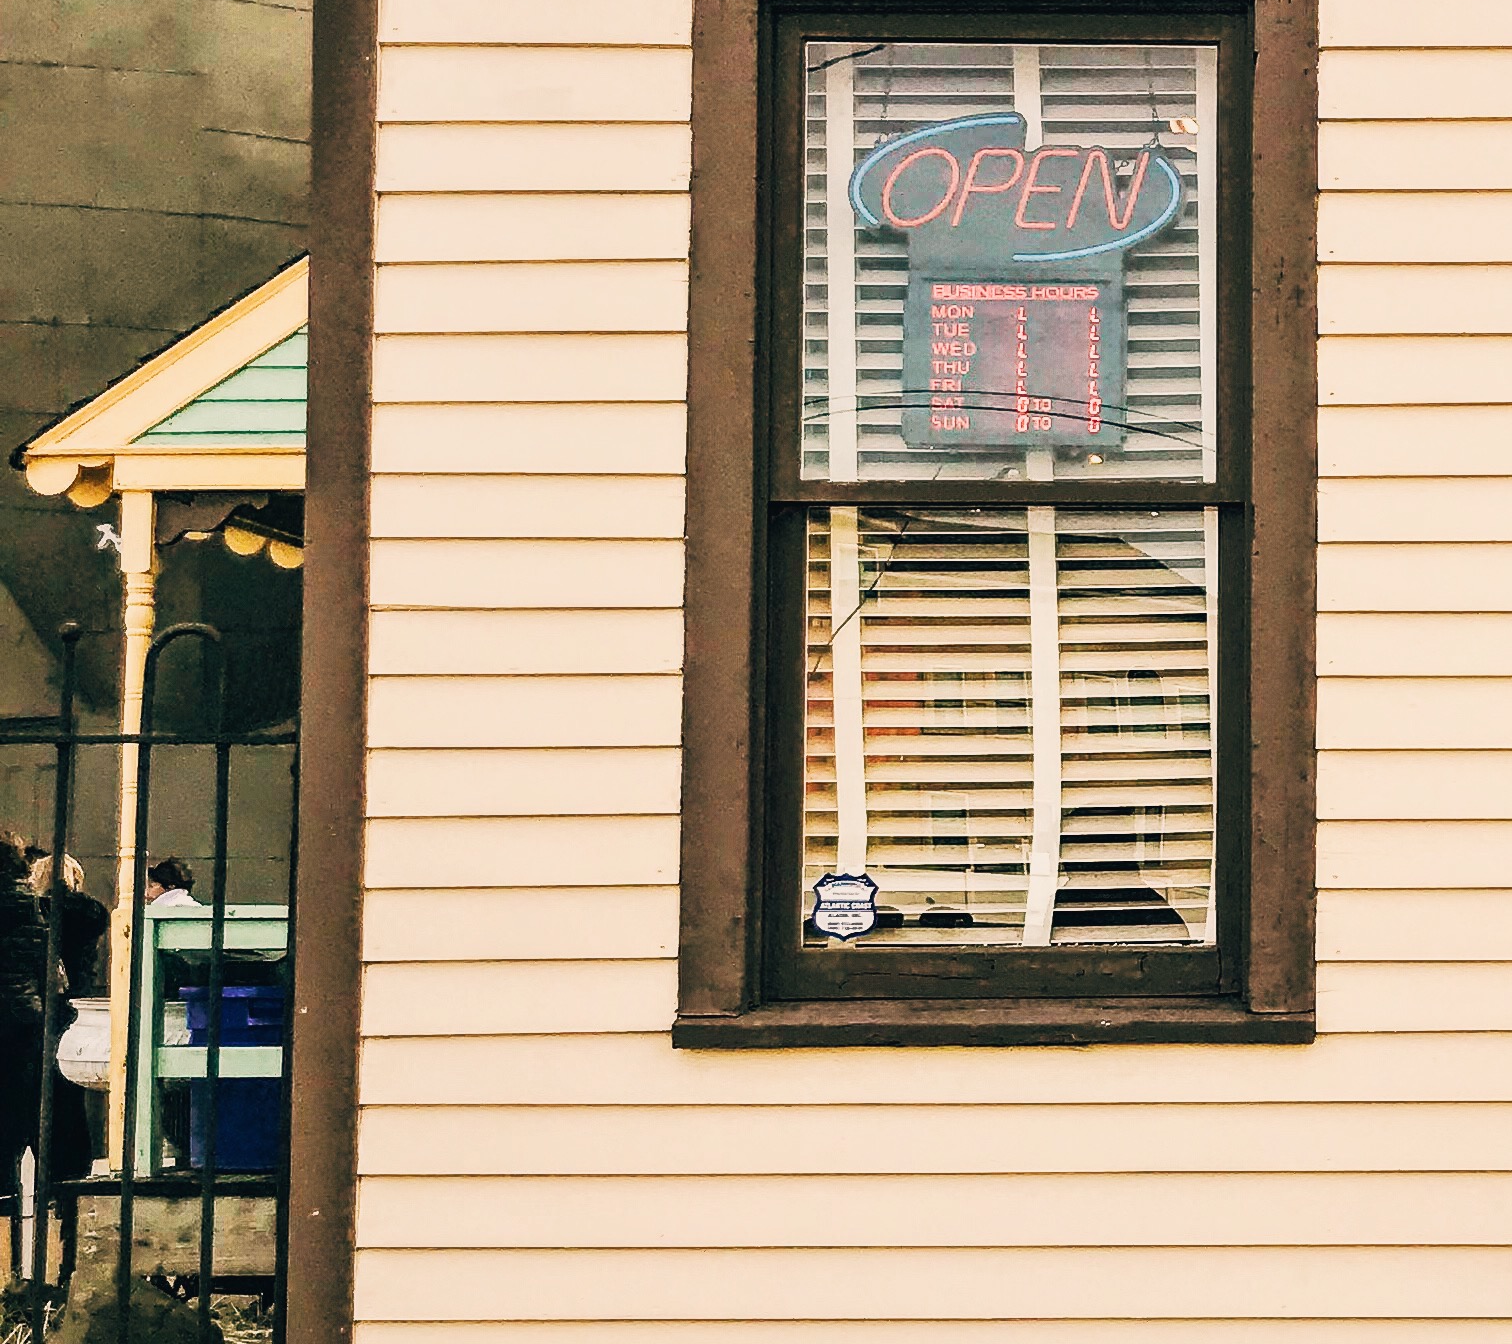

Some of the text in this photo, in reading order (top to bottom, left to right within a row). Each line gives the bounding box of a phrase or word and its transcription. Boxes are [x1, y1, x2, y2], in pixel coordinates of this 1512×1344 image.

[881, 147, 1150, 230] OPEN
[932, 284, 1100, 300] BUSINESS HOURS
[931, 304, 975, 319] MON
[932, 322, 970, 337] TUE
[931, 341, 977, 356] WED
[932, 360, 970, 375] THU
[930, 378, 963, 392] FRI
[931, 396, 965, 411] SAT
[1032, 398, 1052, 411] TO
[931, 416, 970, 431] SUN
[1032, 416, 1052, 431] TO
